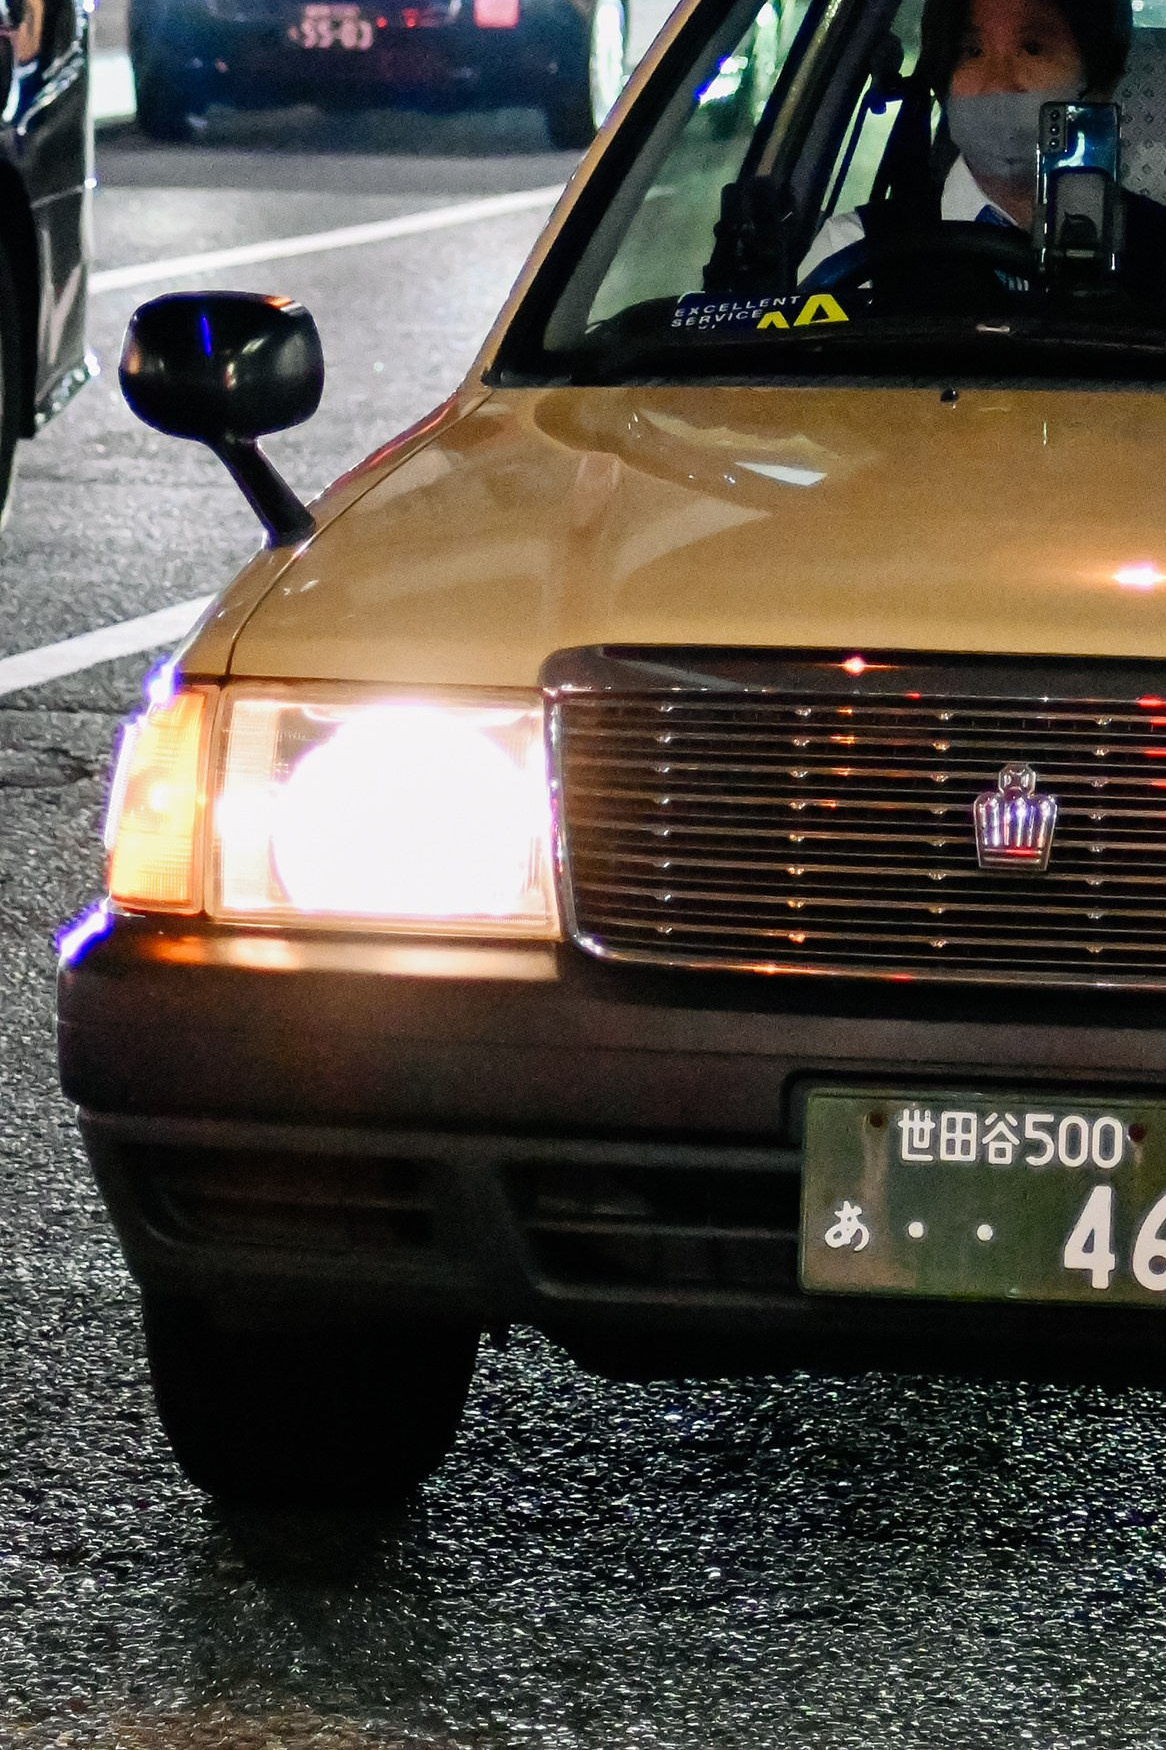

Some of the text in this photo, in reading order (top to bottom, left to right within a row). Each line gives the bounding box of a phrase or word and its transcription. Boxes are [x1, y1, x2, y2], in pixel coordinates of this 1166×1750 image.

[671, 309, 764, 328] SERVICE
[674, 295, 801, 317] EXCELLENT
[898, 1108, 1124, 1169] 世田谷500
[824, 1200, 870, 1252] あ
